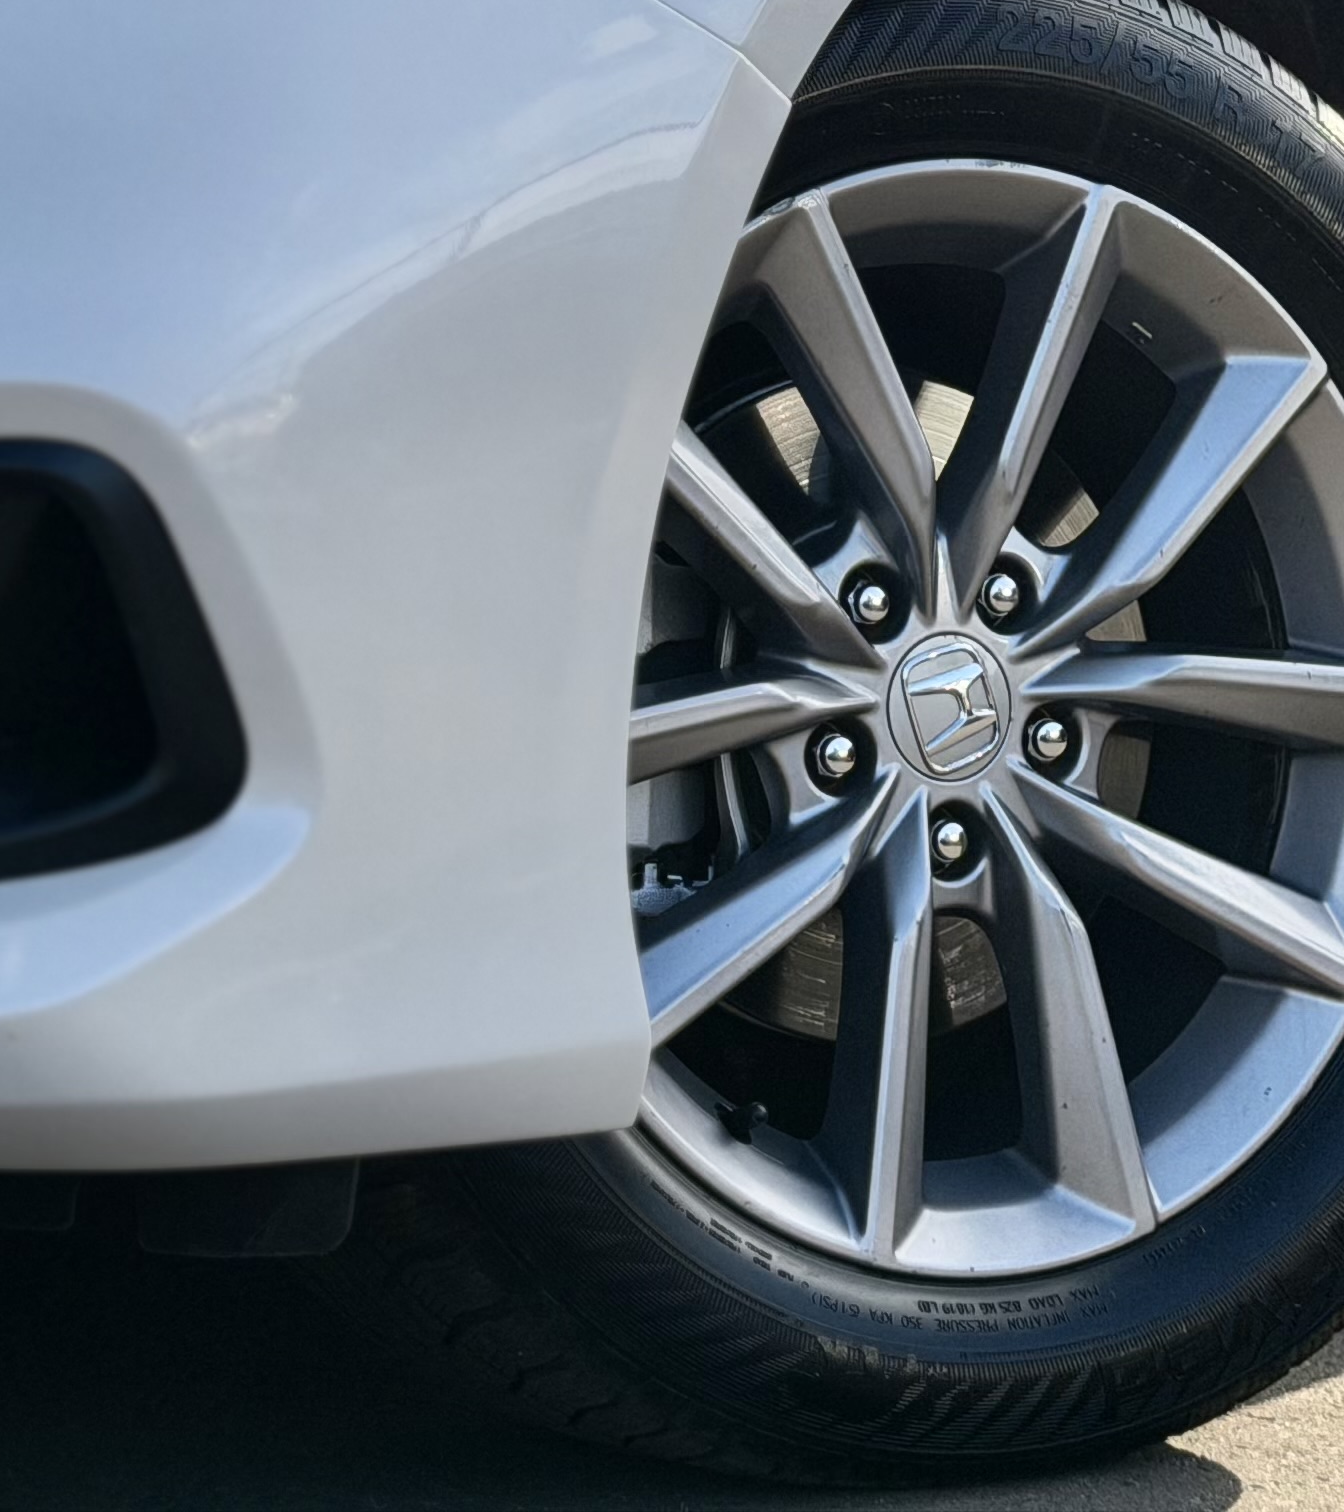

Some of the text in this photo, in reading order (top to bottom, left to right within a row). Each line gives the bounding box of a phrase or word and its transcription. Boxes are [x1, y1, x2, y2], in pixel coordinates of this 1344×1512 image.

[997, 3, 1200, 99] 225/55
[1214, 82, 1253, 128] R
[1070, 1285, 1099, 1301] MAX
[869, 1308, 894, 1325] KPA
[1079, 1302, 1109, 1319] MAX
[901, 1315, 924, 1330] 350
[935, 1319, 999, 1333] PRESSURE
[1007, 1311, 1071, 1332] INFLATION
